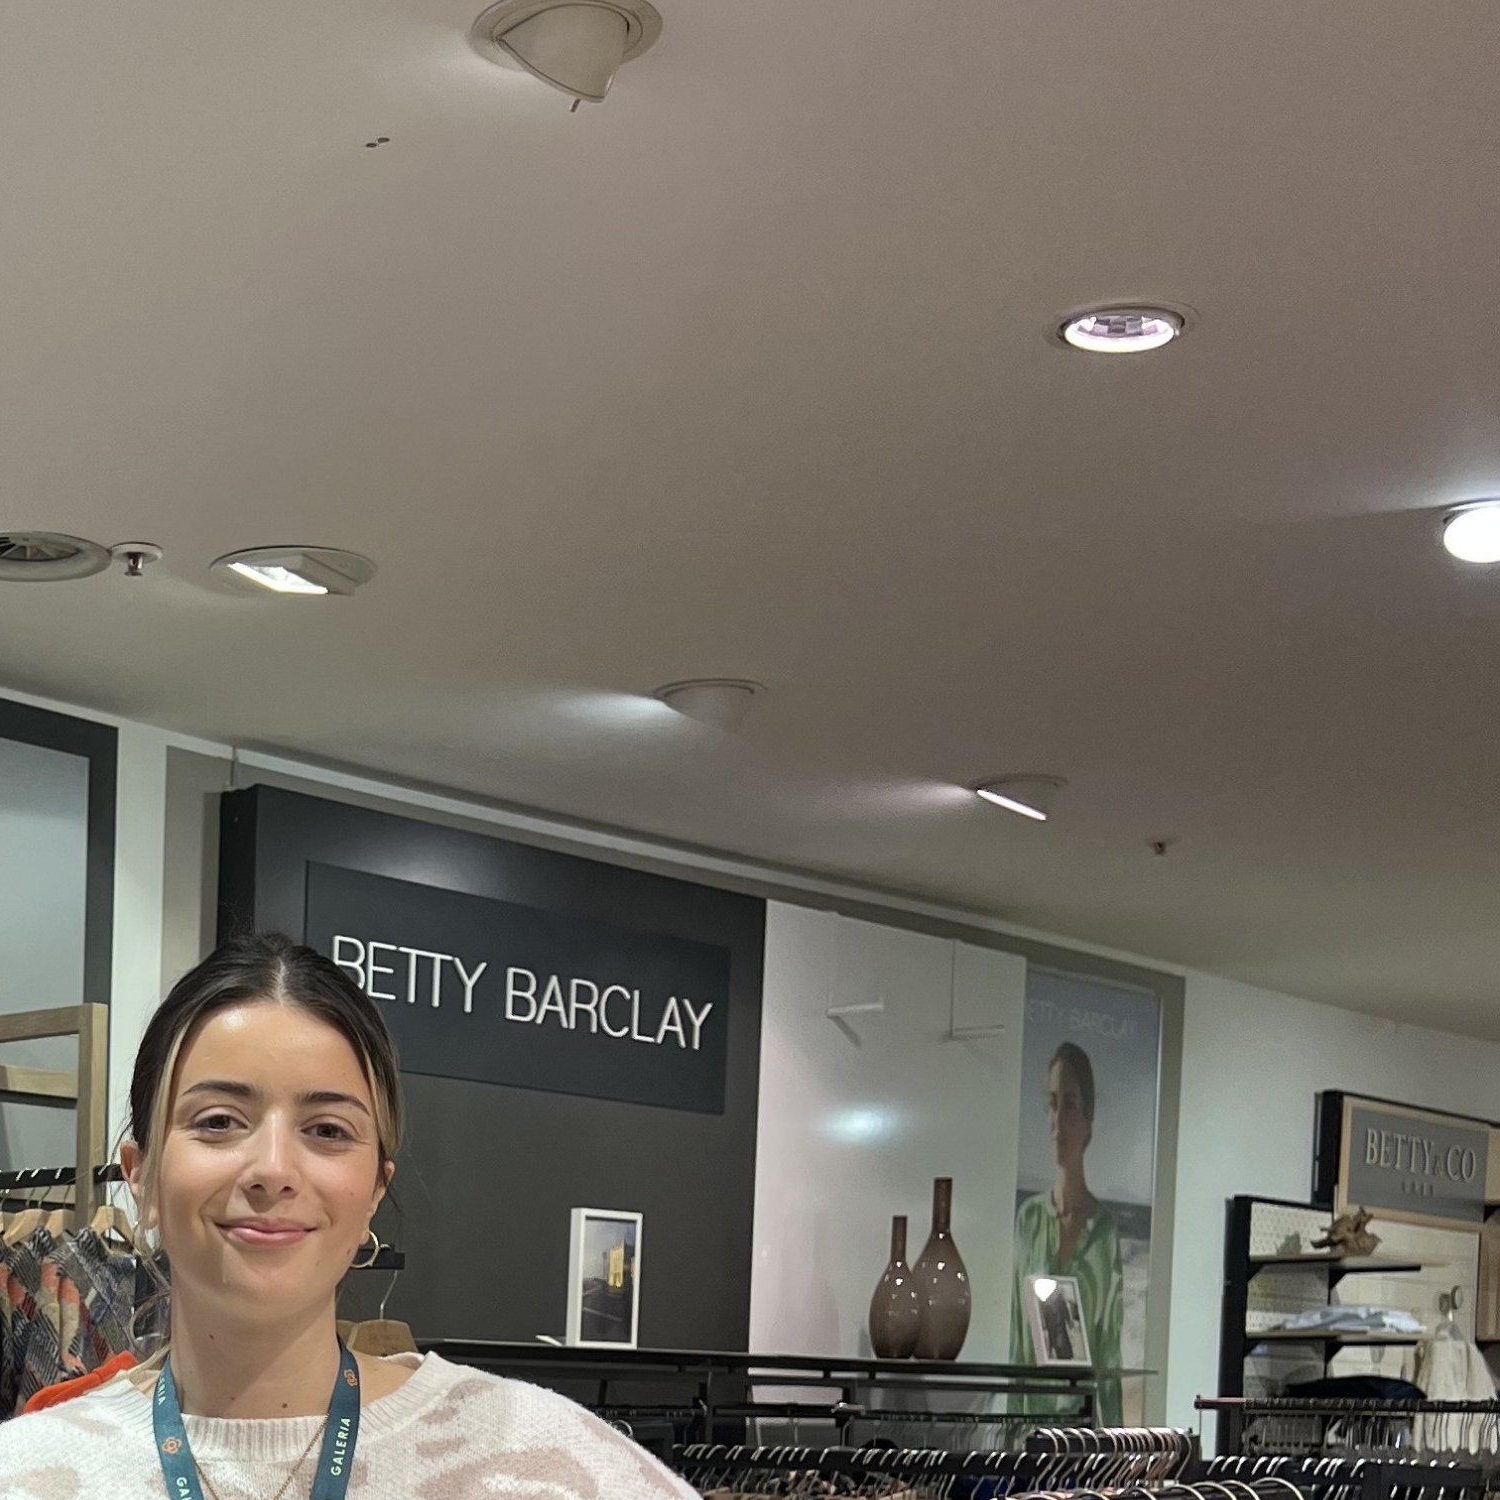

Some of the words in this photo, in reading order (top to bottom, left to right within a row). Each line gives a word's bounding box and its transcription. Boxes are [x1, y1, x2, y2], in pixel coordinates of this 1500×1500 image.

[332, 934, 487, 1014] BETTY
[504, 966, 714, 1051] BARCLAY
[330, 1417, 352, 1476] GALERIA
